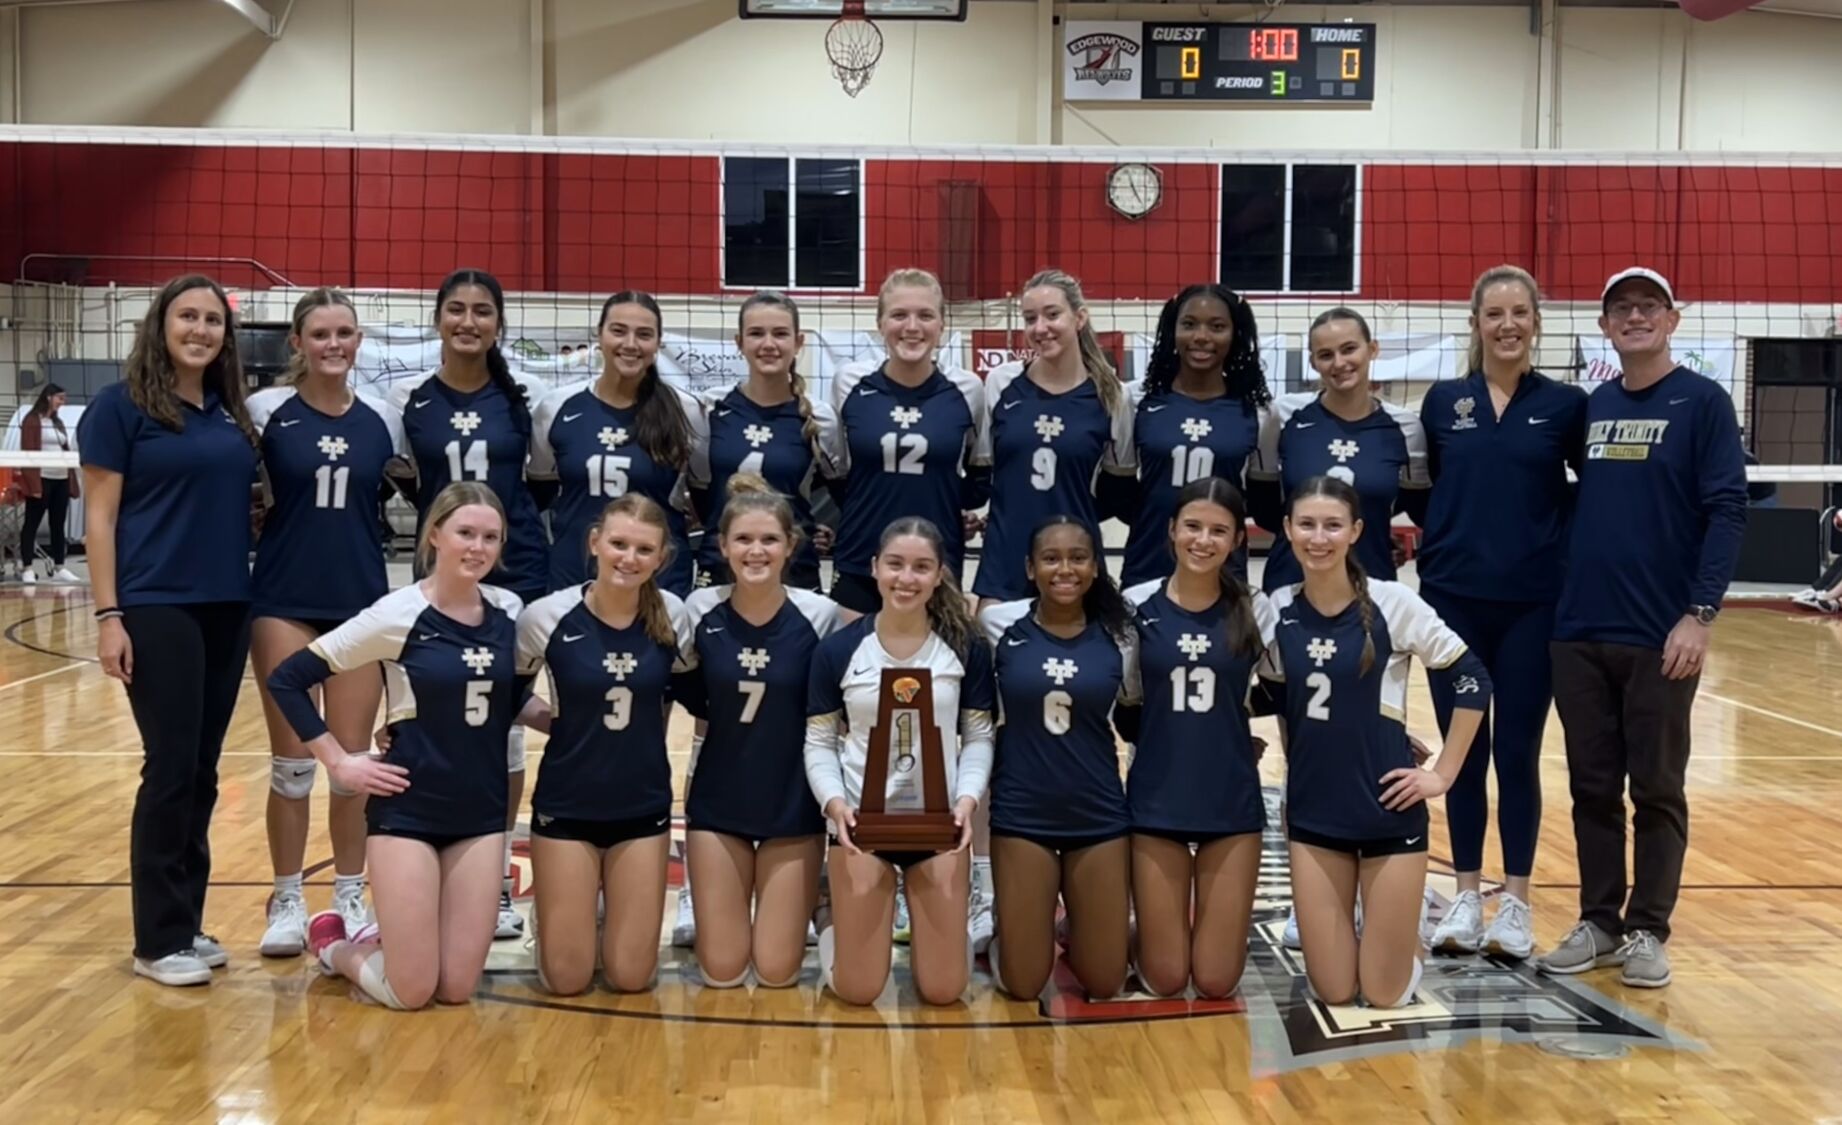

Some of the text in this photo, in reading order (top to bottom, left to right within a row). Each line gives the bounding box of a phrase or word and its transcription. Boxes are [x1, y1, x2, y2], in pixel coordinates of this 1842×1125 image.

[1151, 27, 1206, 41] GUEST
[1250, 29, 1298, 60] 1:00
[1315, 28, 1363, 42] HOME
[1181, 47, 1200, 78] 0
[1215, 70, 1286, 95] PERIOD 3
[1341, 48, 1360, 79] 0
[1612, 419, 1670, 444] TRINITY
[445, 440, 489, 482] 14
[880, 432, 928, 475] 12
[1030, 447, 1057, 491] 9
[1171, 445, 1215, 487] 10
[315, 465, 349, 509] 11
[586, 454, 632, 497] 15
[464, 680, 494, 727] 5
[603, 686, 633, 731] 3
[738, 680, 766, 723] 7
[1170, 666, 1216, 713] 13
[1305, 672, 1332, 721] 2
[1043, 690, 1073, 735] 6
